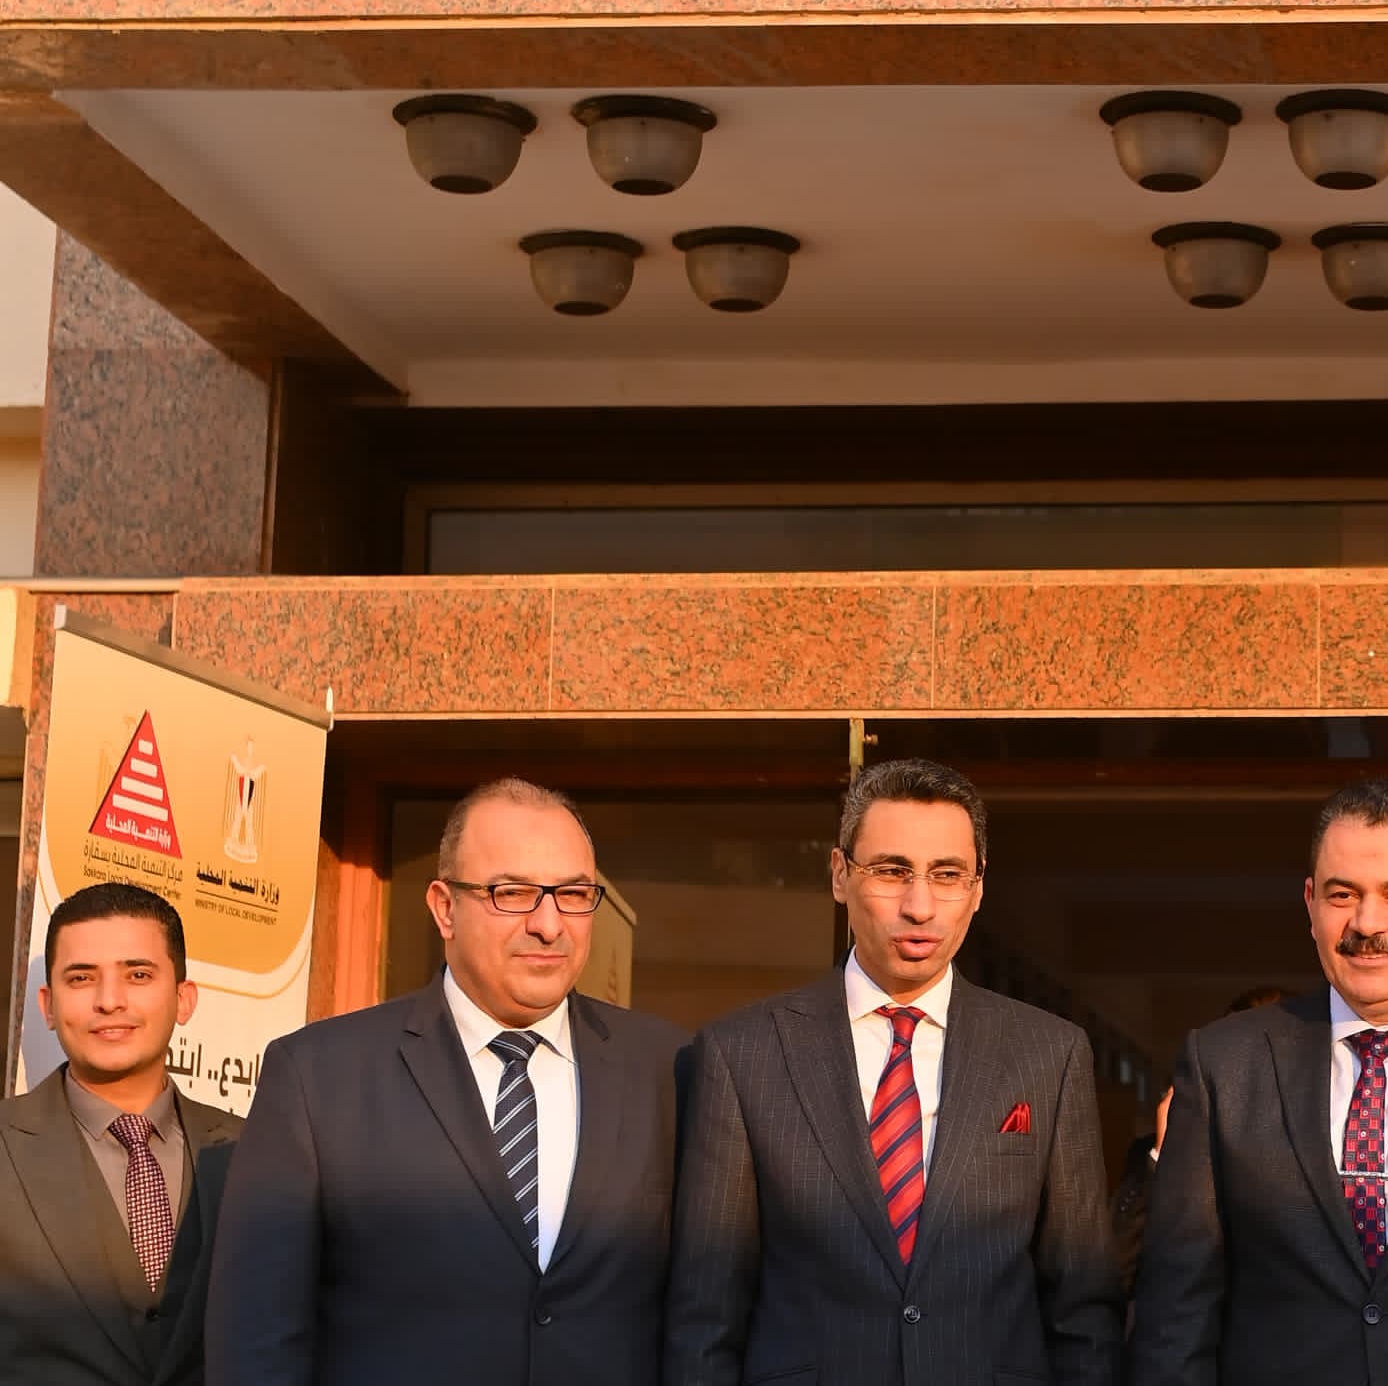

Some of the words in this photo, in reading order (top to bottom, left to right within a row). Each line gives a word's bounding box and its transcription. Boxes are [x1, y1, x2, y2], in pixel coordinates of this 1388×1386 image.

[196, 861, 227, 887] المحلية
[228, 870, 259, 896] التنمية
[261, 879, 280, 905] وزارة
